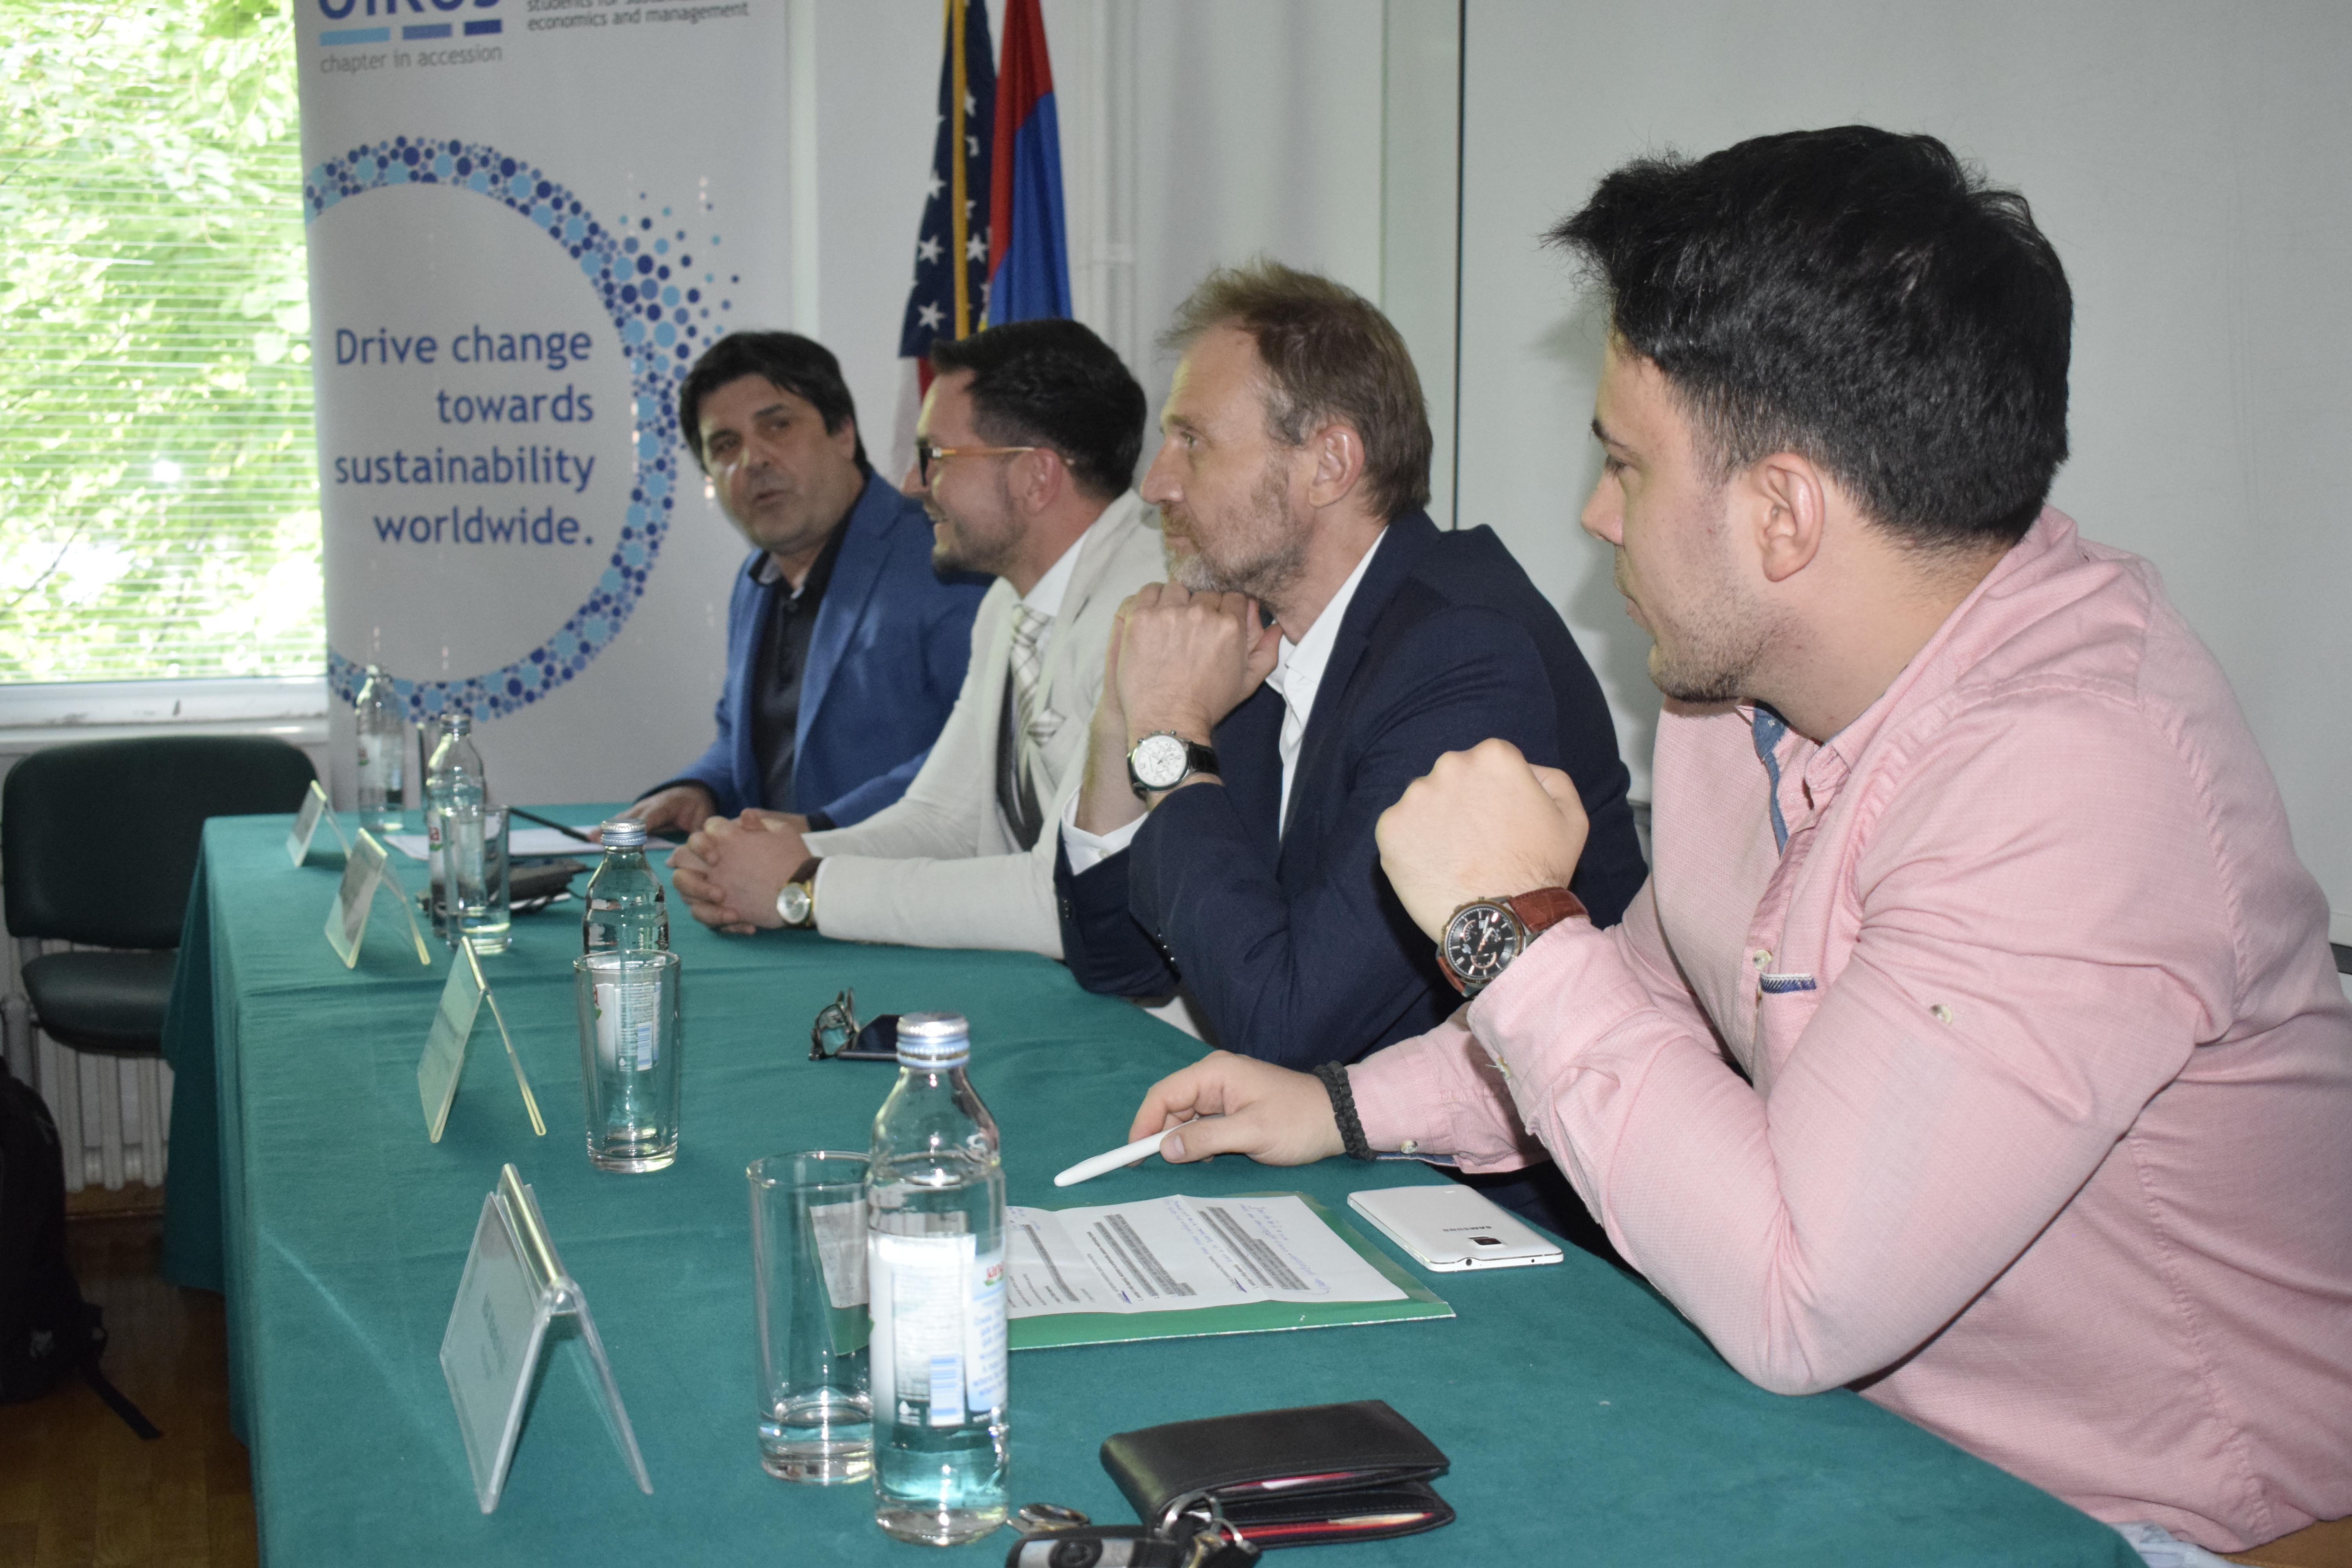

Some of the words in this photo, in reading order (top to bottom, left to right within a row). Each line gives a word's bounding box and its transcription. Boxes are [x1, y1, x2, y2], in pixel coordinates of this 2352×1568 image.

[528, 15, 607, 30] economics
[613, 8, 641, 24] and
[645, 2, 750, 25] management
[319, 53, 387, 75] chapter
[393, 47, 412, 68] in
[417, 44, 503, 67] accession
[335, 327, 438, 365] Drive
[450, 323, 593, 370] change
[436, 383, 594, 423] towards
[334, 446, 595, 493] sustainability
[373, 505, 593, 544] worldwide.
